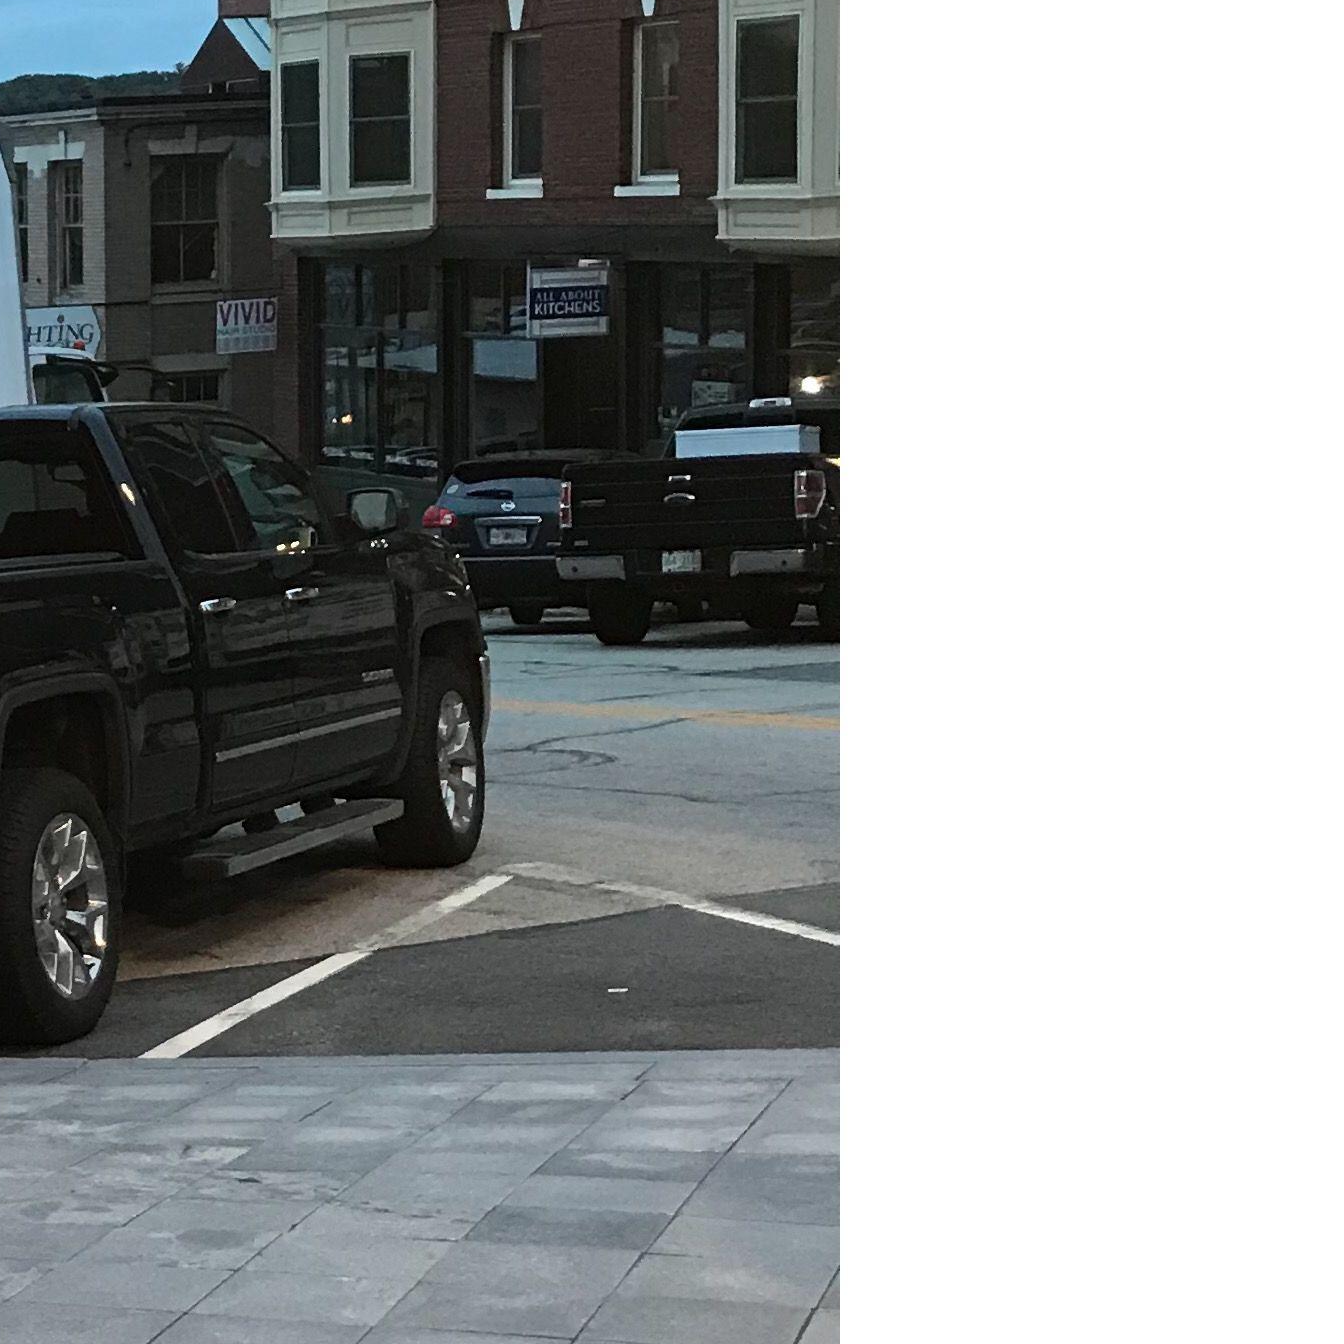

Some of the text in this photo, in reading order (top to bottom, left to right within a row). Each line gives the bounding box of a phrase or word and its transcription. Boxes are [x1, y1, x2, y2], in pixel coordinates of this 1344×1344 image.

[535, 289, 601, 302] ALL ABOUT
[219, 301, 276, 327] VIVID
[534, 300, 601, 315] KITCHENS
